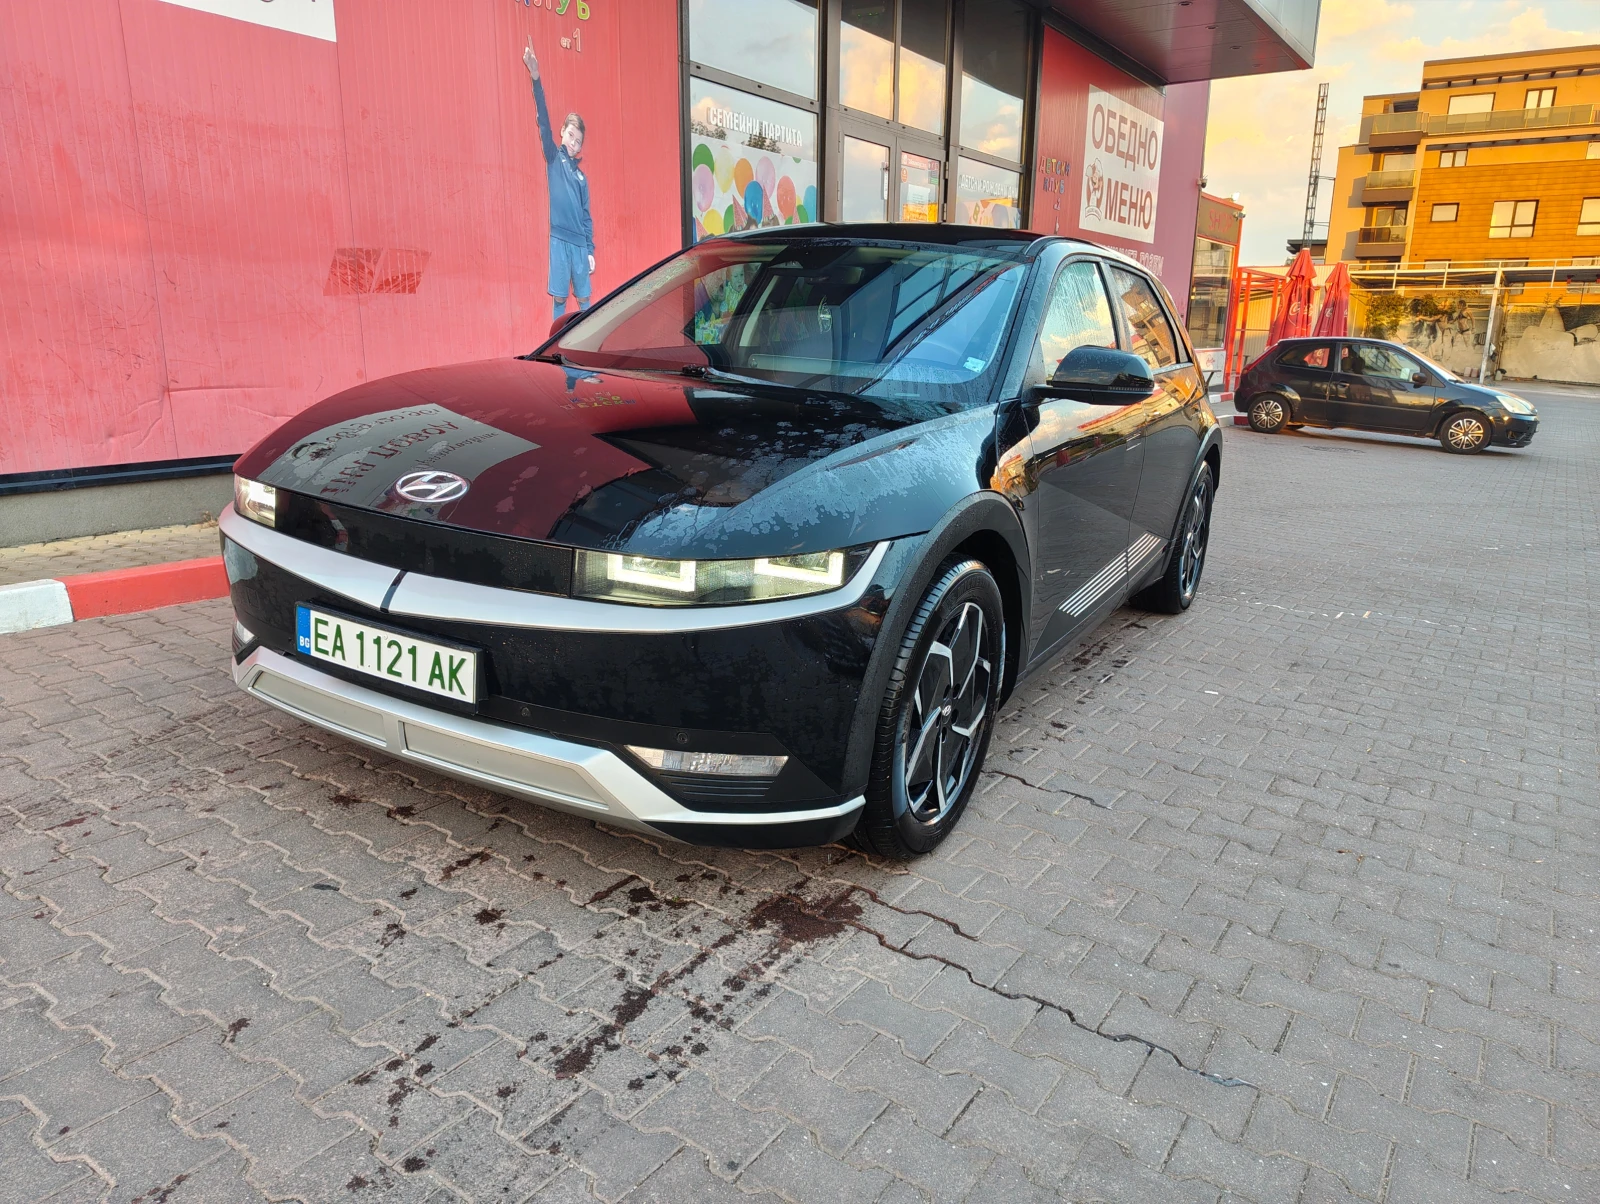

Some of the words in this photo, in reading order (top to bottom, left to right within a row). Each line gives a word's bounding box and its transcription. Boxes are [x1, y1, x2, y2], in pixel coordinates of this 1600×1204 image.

[709, 107, 760, 136] СЕМЕЙНИ
[761, 120, 803, 147] ПАРТИТА
[1092, 103, 1158, 171] ОБЕДНО
[1039, 155, 1070, 176] ДЕТСКИ
[1043, 176, 1065, 194] КЛУБ
[1105, 178, 1153, 230] МЕНЮ
[299, 635, 311, 649] BG
[314, 617, 347, 662] EA
[355, 630, 418, 682] 1121
[427, 651, 468, 697] AK
